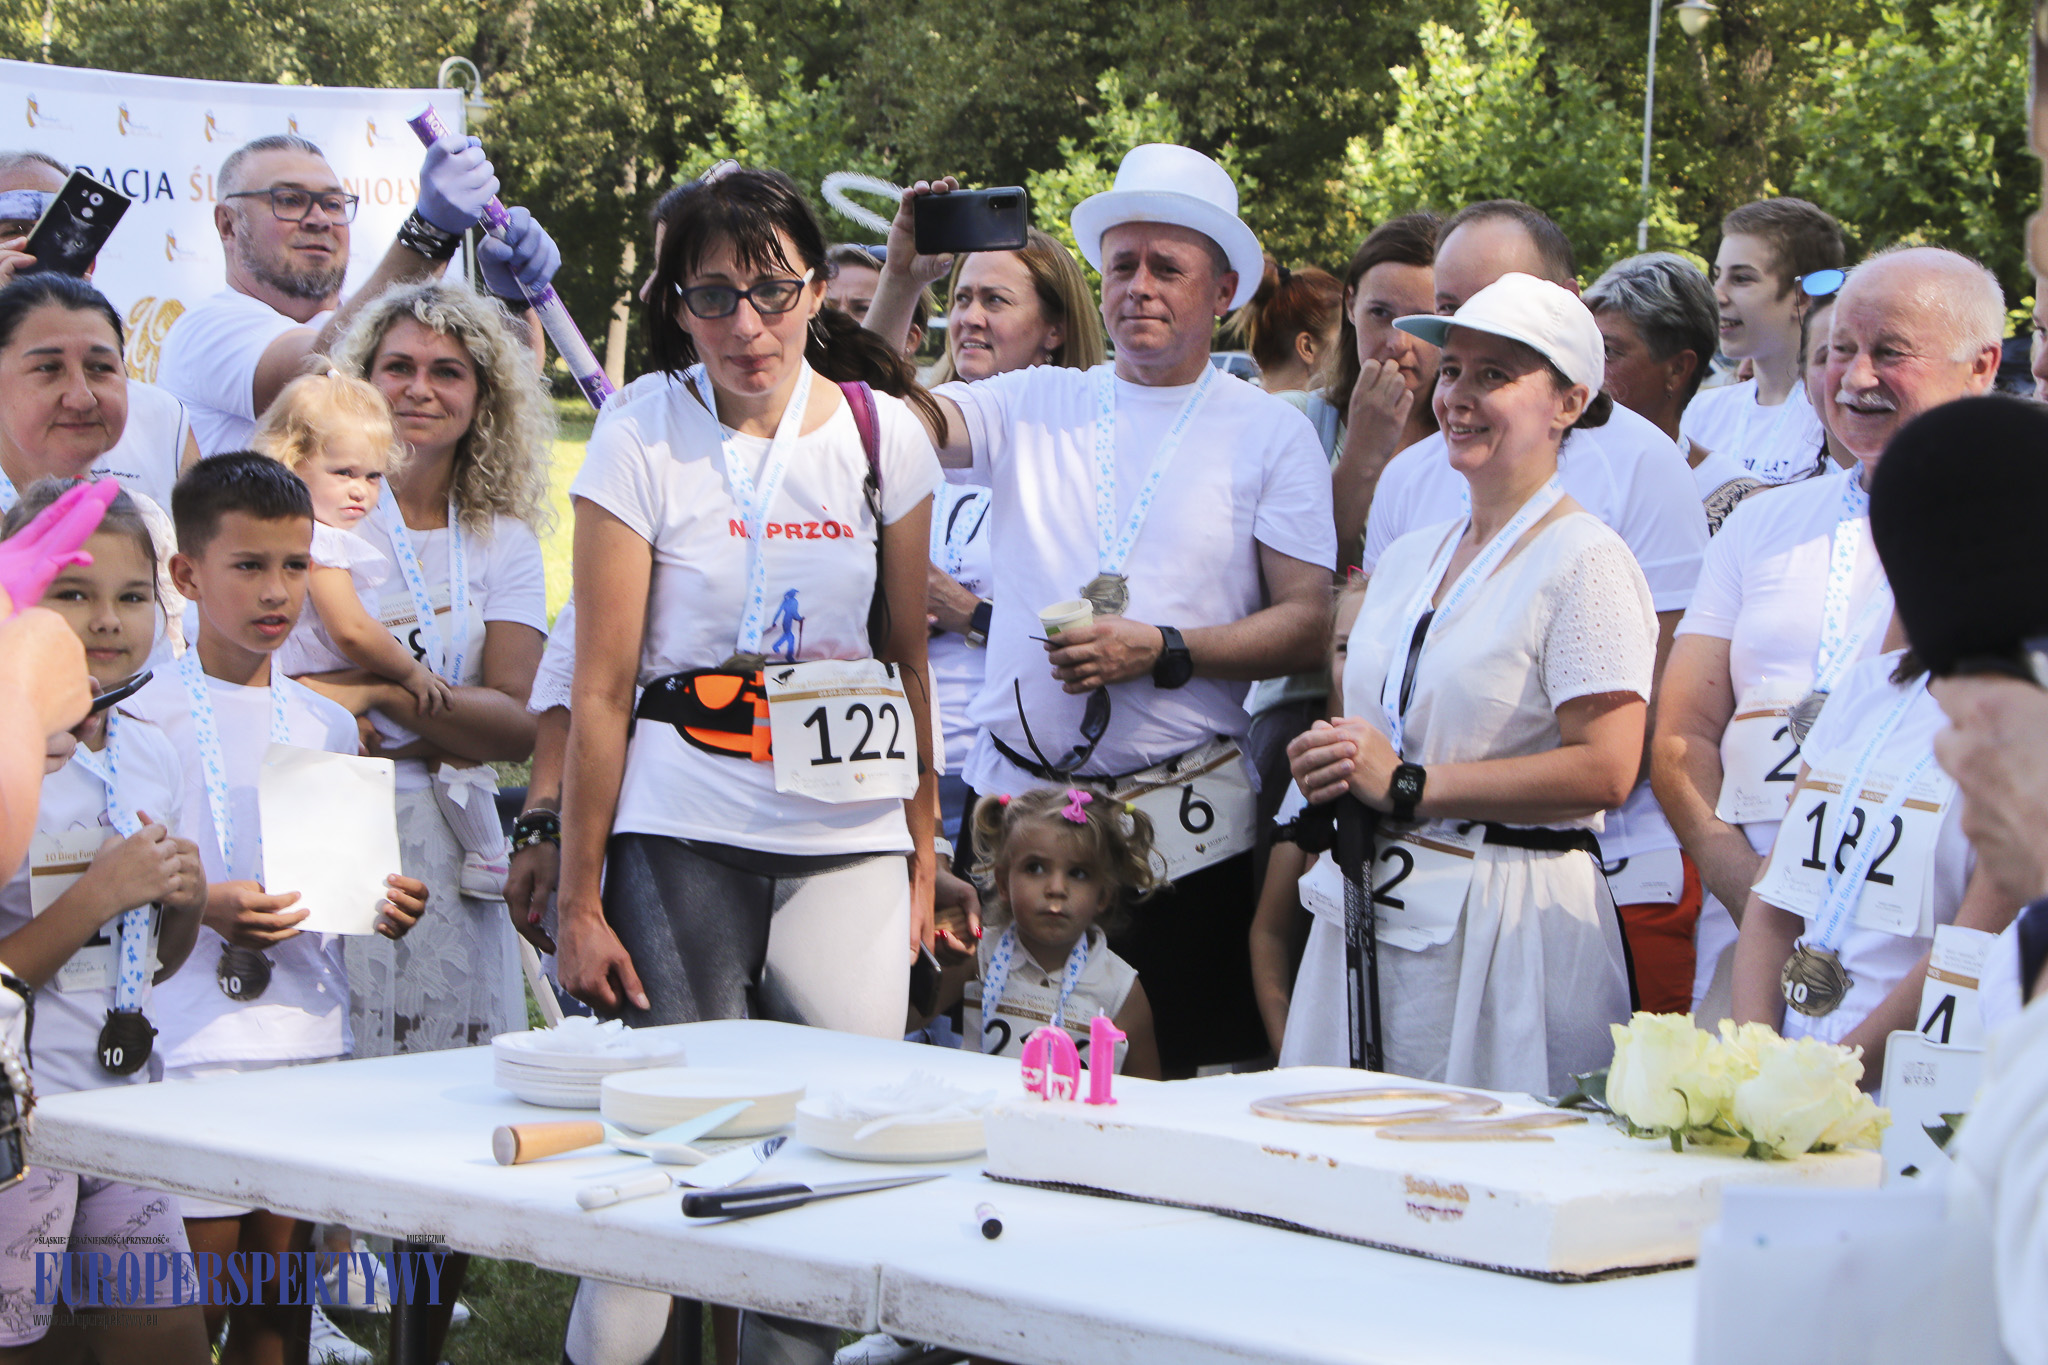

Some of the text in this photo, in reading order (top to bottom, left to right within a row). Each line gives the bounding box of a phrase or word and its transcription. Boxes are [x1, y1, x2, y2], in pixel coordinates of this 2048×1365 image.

[728, 505, 855, 540] NPRZÓD
[803, 702, 905, 766] 122
[1179, 783, 1214, 835] 6
[1802, 800, 1903, 887] 182
[1818, 825, 1882, 950] Fundacji Śląskie Anioły
[220, 976, 242, 995] 10
[1783, 979, 1809, 1004] 10
[103, 1047, 124, 1066] 10
